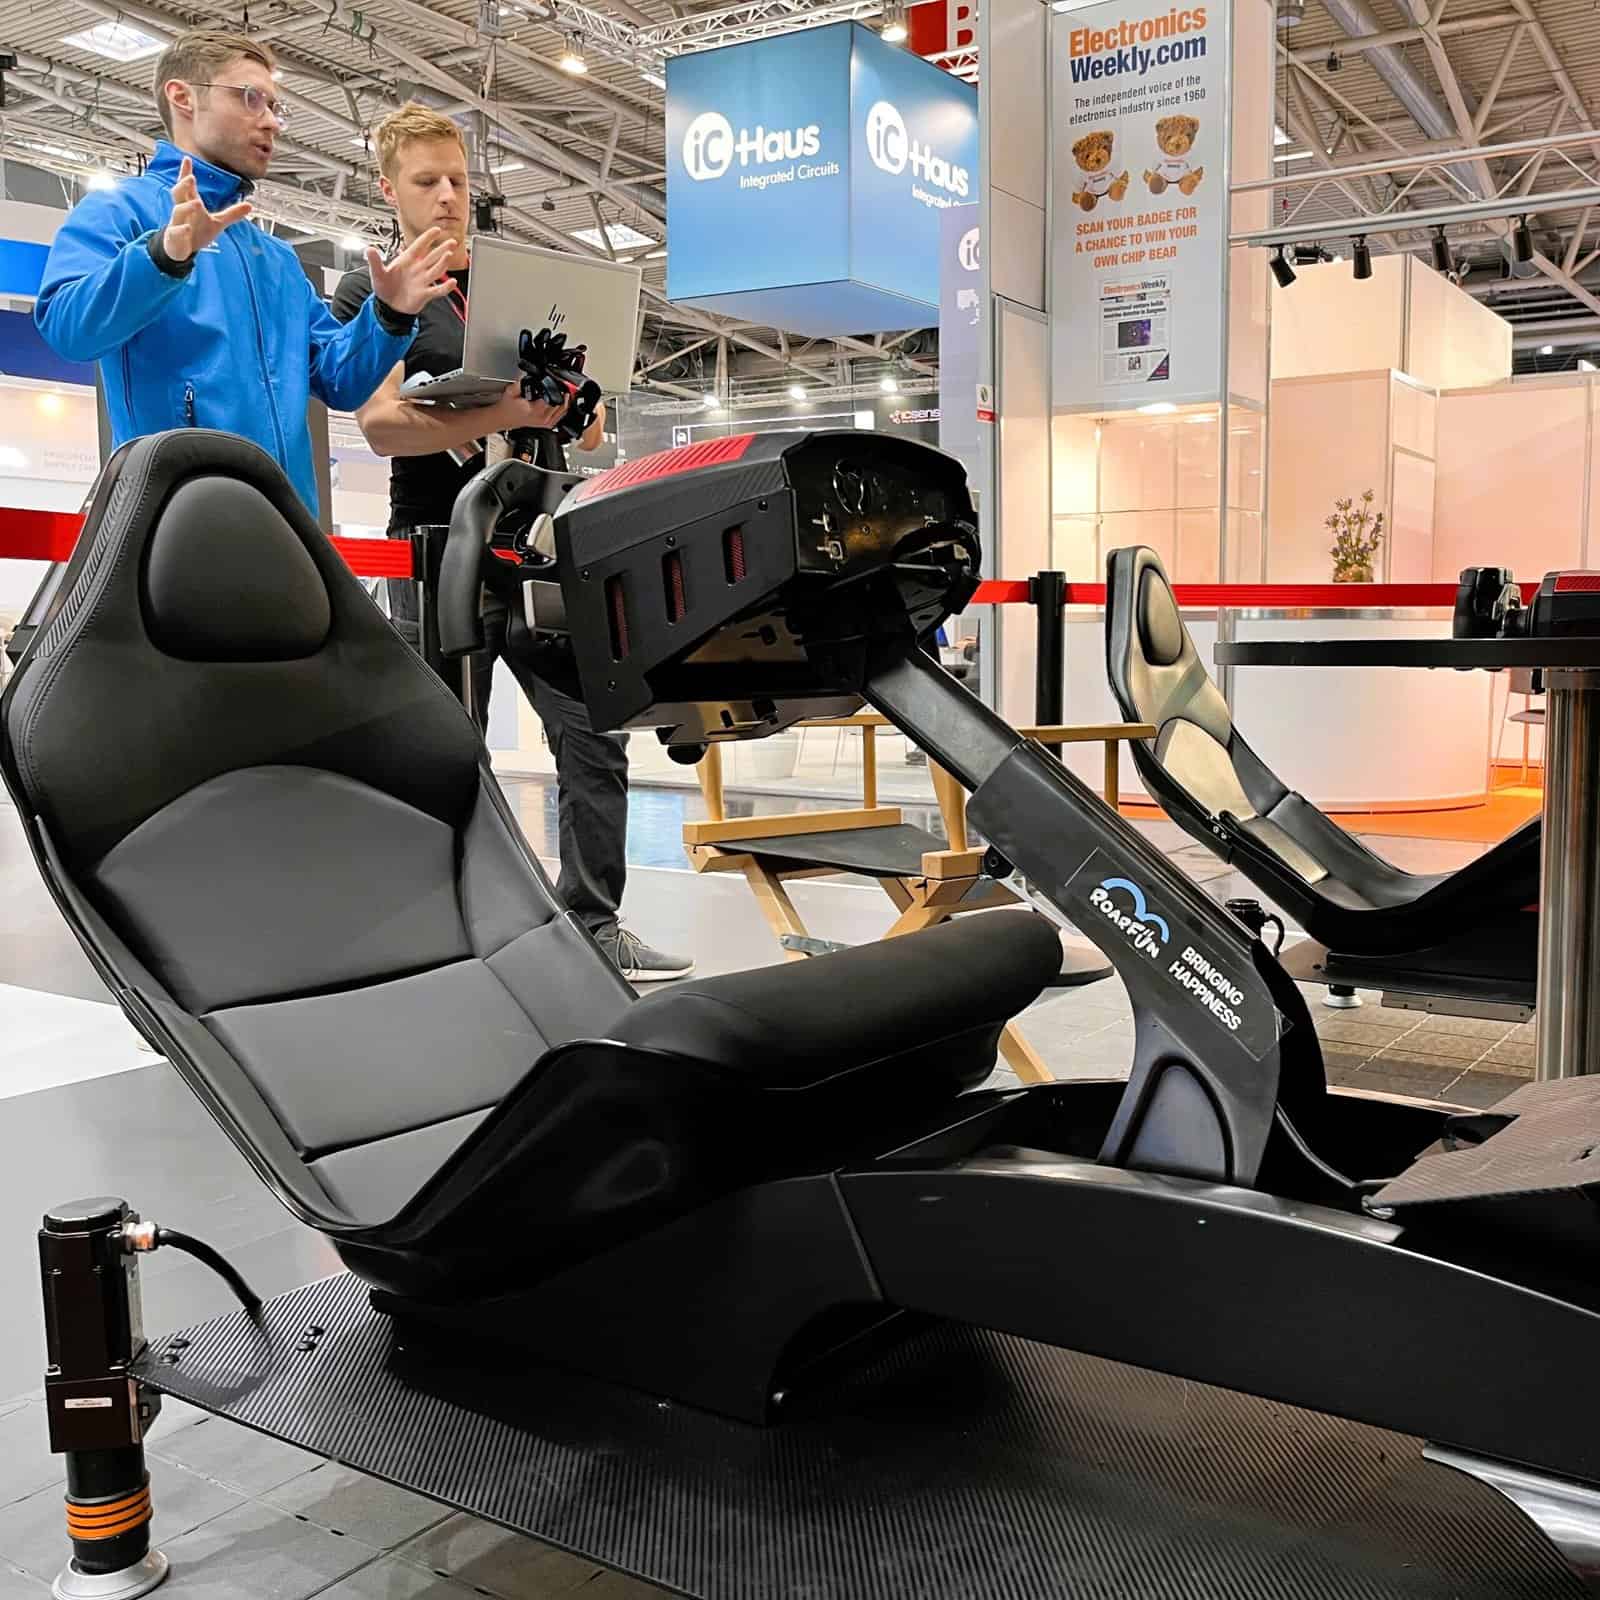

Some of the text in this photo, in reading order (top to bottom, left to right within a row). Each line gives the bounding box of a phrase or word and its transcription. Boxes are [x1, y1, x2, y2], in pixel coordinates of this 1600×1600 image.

[1070, 8, 1206, 57] Electronics
[1071, 36, 1206, 83] Weekly.com
[1070, 88, 1206, 125] electronics industry since 1960
[1075, 75, 1201, 110] The independent voice of the
[735, 124, 820, 167] Haus
[740, 162, 840, 190] Integrated Circuits
[909, 139, 968, 197] Haus
[1076, 207, 1197, 236] SCAN YOUR BADGE FOR
[1076, 225, 1197, 253] A CHANCE TO WIN YOUR
[1094, 246, 1177, 268] OWN CHIP BEAR
[1168, 961, 1242, 1031] HAPPINESS
[1181, 946, 1244, 1006] BRINGING
